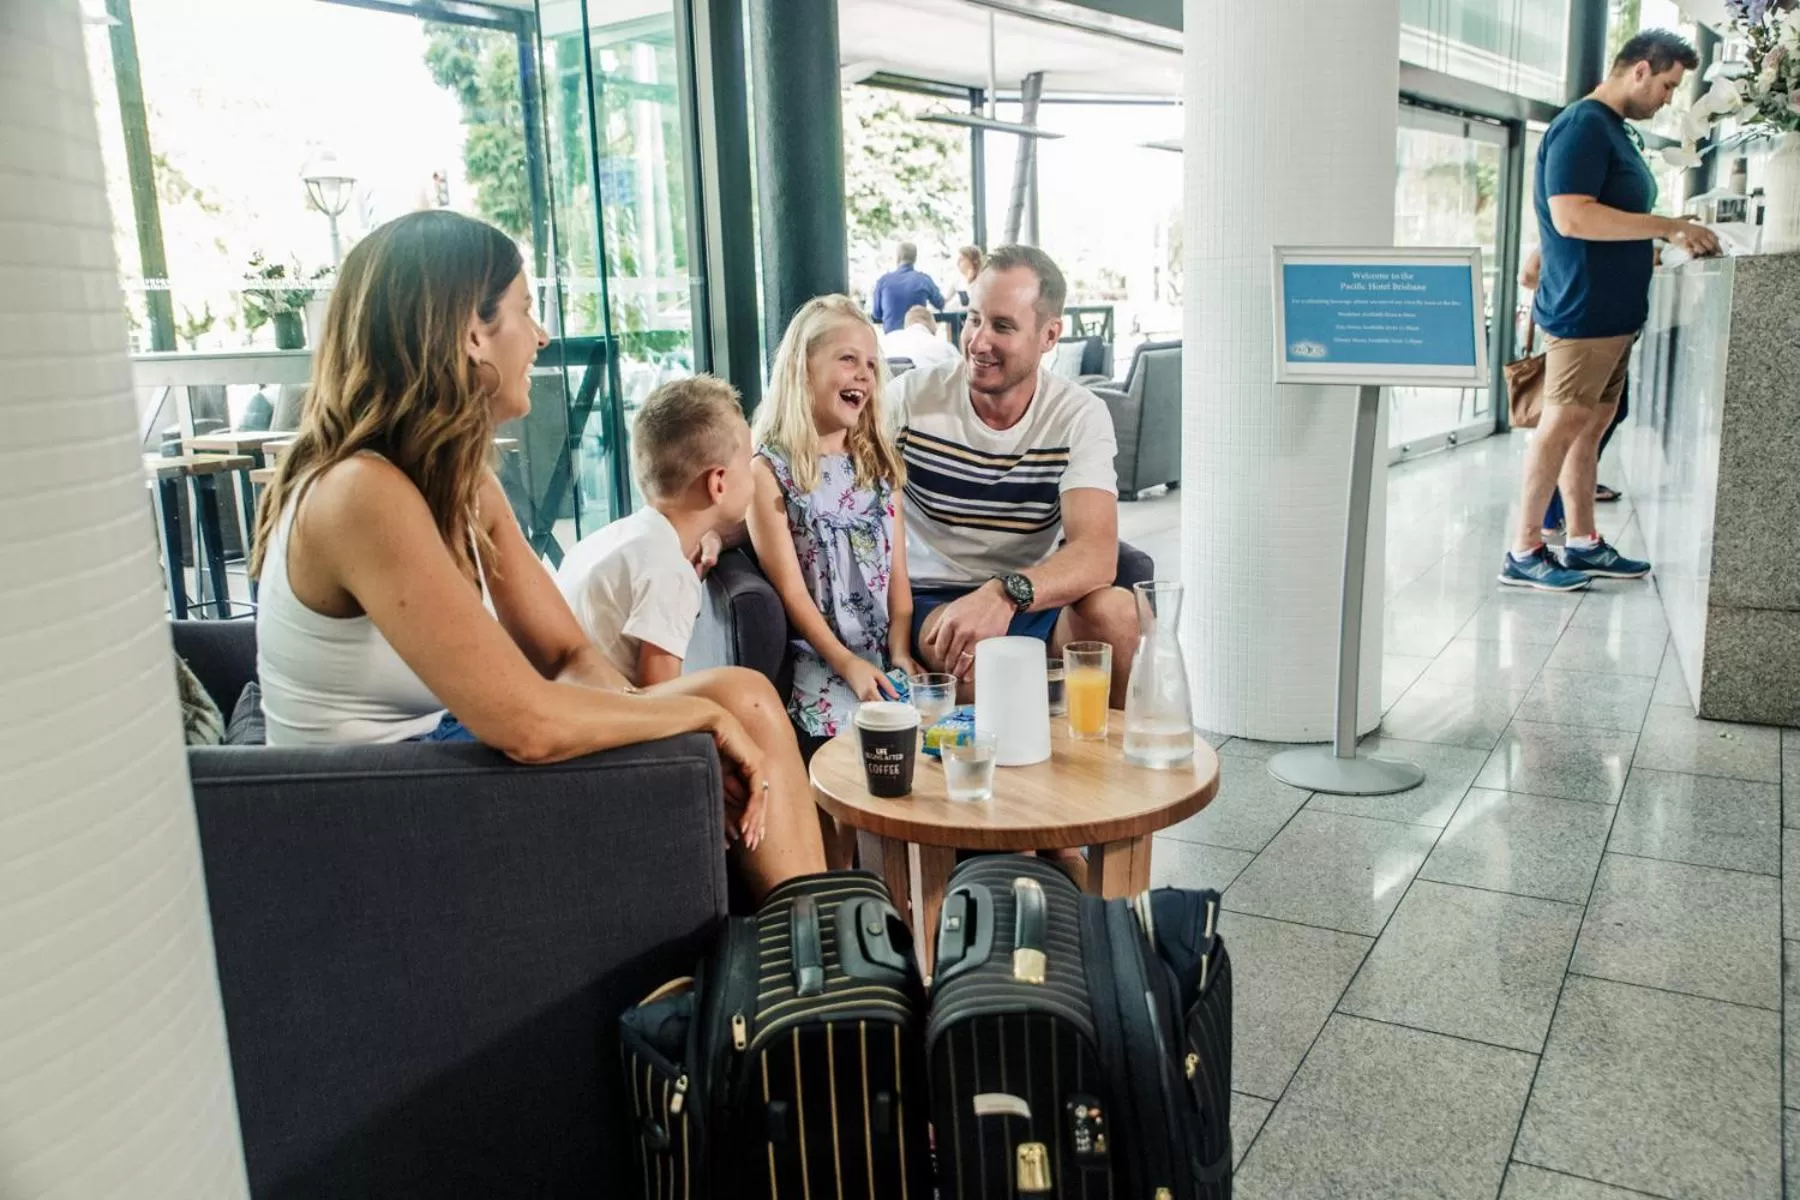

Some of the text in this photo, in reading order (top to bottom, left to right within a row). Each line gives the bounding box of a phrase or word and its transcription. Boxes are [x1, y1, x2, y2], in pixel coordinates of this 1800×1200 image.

[1352, 271, 1414, 281] Welcome to the
[1340, 281, 1427, 292] Pacific Hotel Brisbane
[868, 763, 901, 775] COFFEE
